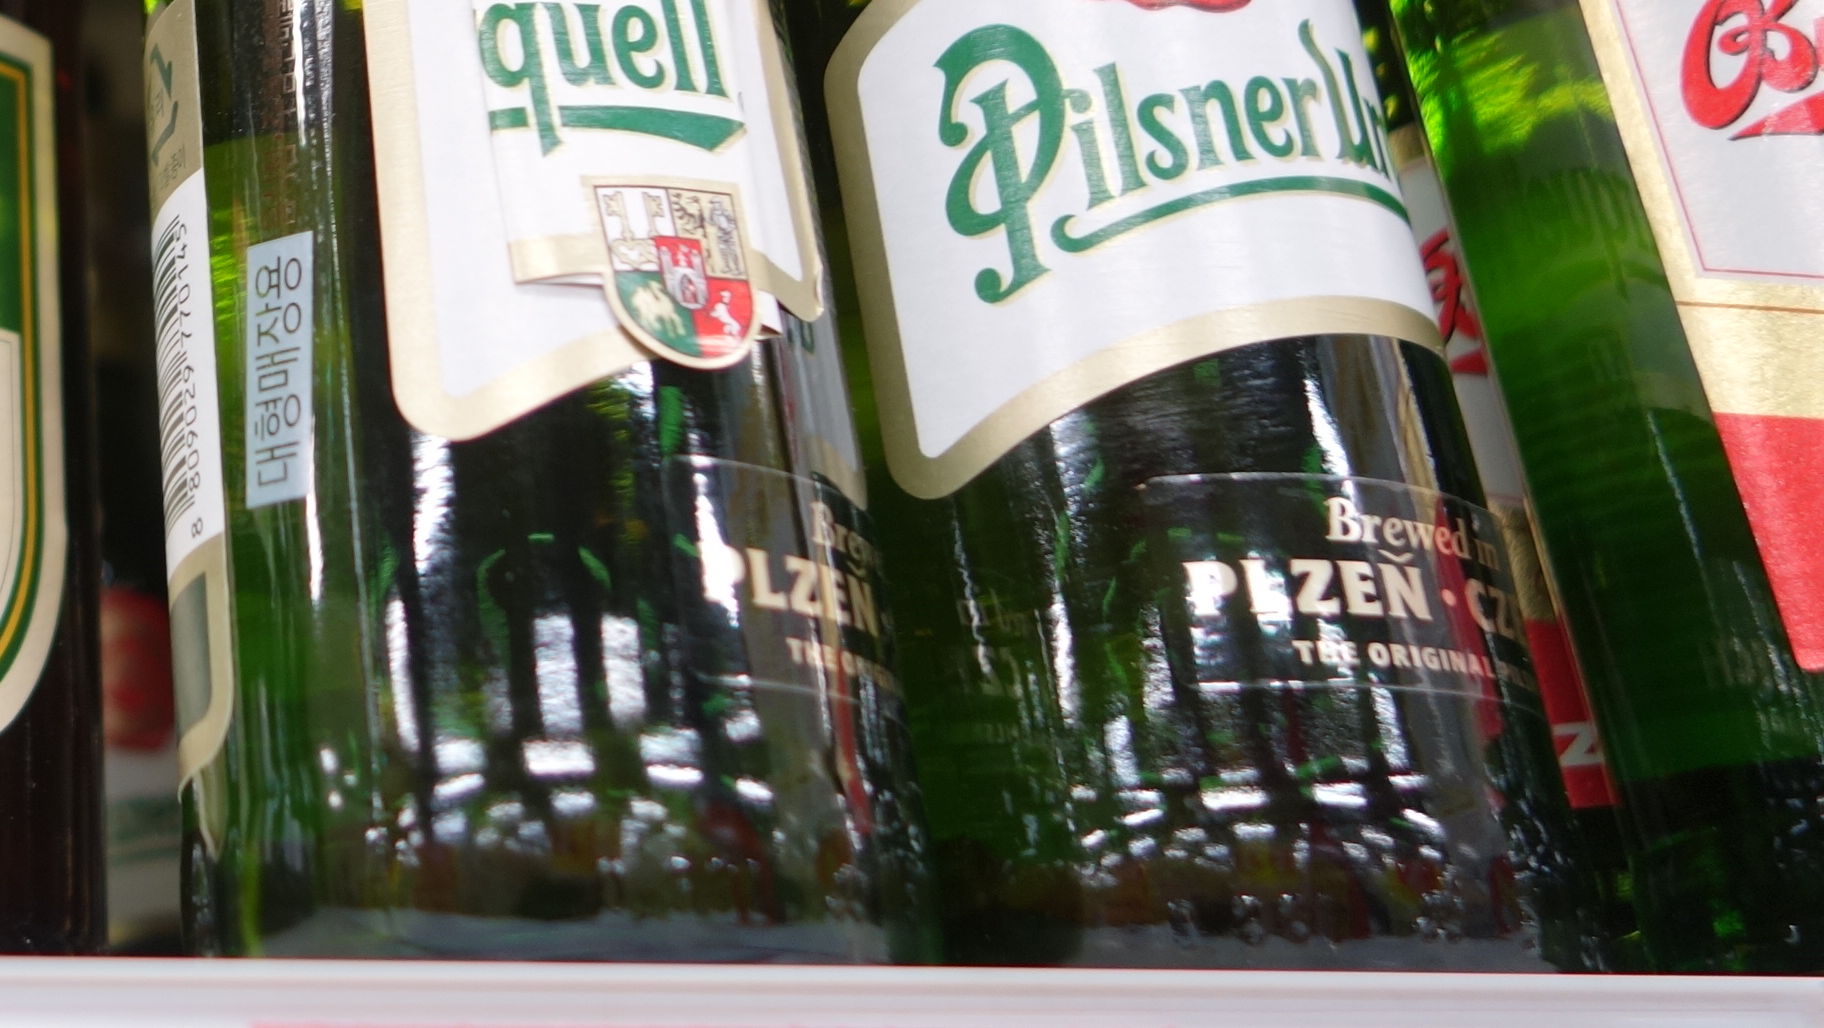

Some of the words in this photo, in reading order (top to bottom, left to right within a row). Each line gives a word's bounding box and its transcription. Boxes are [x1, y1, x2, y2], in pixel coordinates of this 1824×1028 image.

[930, 22, 1321, 306] Pilsner
[254, 255, 303, 488] 대형매장용
[1323, 495, 1472, 560] Brewed
[1366, 642, 1498, 679] ORIGINAL
